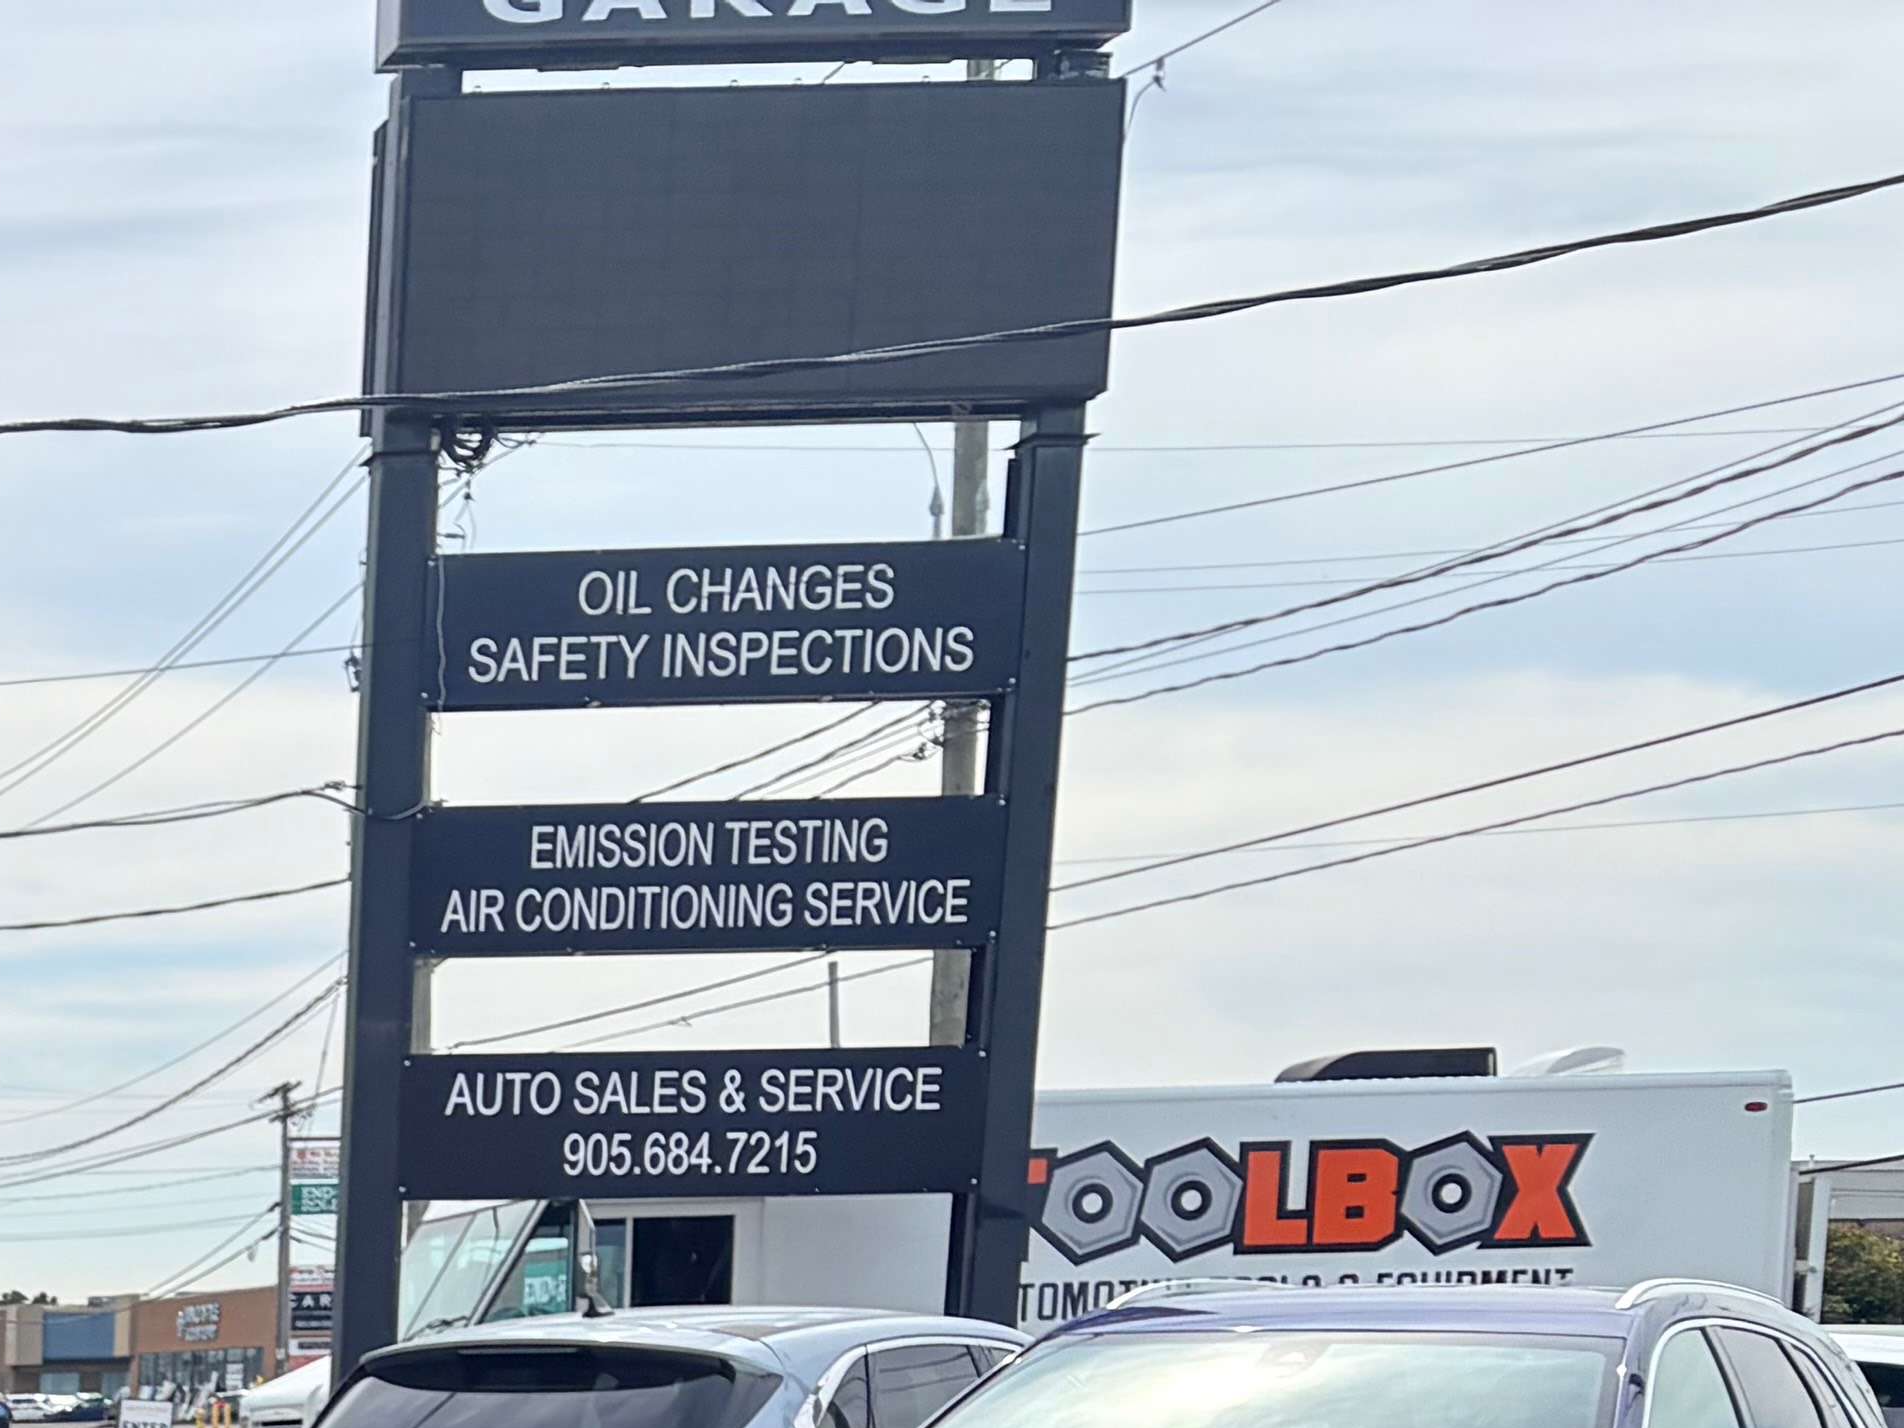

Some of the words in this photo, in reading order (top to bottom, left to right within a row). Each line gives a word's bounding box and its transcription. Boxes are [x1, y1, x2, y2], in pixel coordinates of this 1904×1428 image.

[578, 570, 652, 616] OIL
[666, 564, 895, 614] CHANGES
[468, 633, 648, 683] SAFETY
[662, 626, 974, 678] INSPECTIONS
[530, 823, 714, 869] EMISSION
[724, 817, 888, 865] TESTING
[440, 889, 505, 933] AIR
[515, 883, 793, 932] CONDITIONING
[804, 879, 971, 927] SERVICE
[444, 1071, 561, 1116] AUTO
[573, 1069, 707, 1115] SALES
[719, 1069, 746, 1114] &
[758, 1067, 943, 1113] SERVICE
[563, 1130, 818, 1176] 905.684.7215
